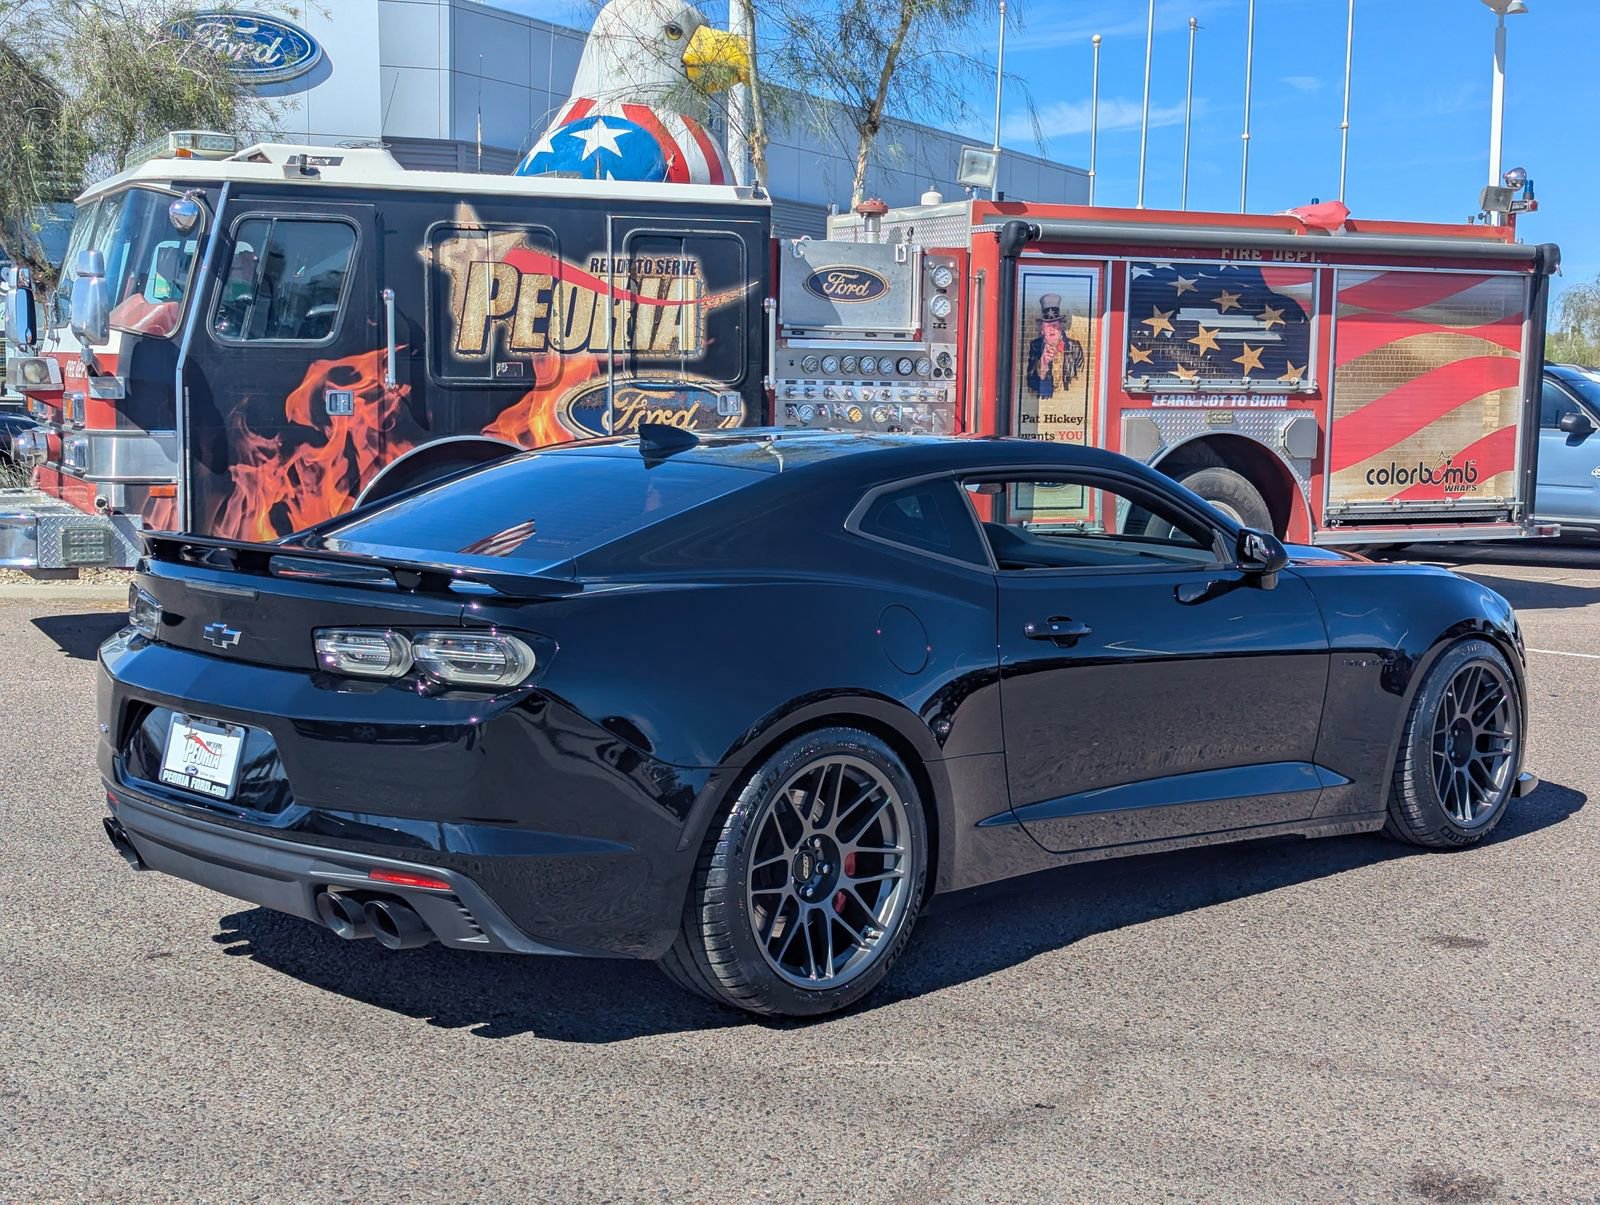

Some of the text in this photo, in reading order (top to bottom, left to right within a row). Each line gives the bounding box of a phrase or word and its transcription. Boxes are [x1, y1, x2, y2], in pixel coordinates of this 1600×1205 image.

[1221, 247, 1262, 260] FIRE
[590, 257, 697, 275] READY TO SERVE
[822, 271, 871, 296] Ford
[455, 260, 700, 353] PEORIA
[65, 360, 77, 378] FIRE
[601, 387, 701, 431] Ford
[1152, 394, 1288, 407] LEARN NOT TO BURN
[1021, 414, 1084, 426] Pat Hickey
[1021, 430, 1083, 441] wants YOU
[1366, 456, 1478, 486] colorbomb
[1444, 484, 1477, 492] WRAPS
[183, 740, 222, 769] PEORIA
[163, 770, 226, 797] PEORIA FORD.com
